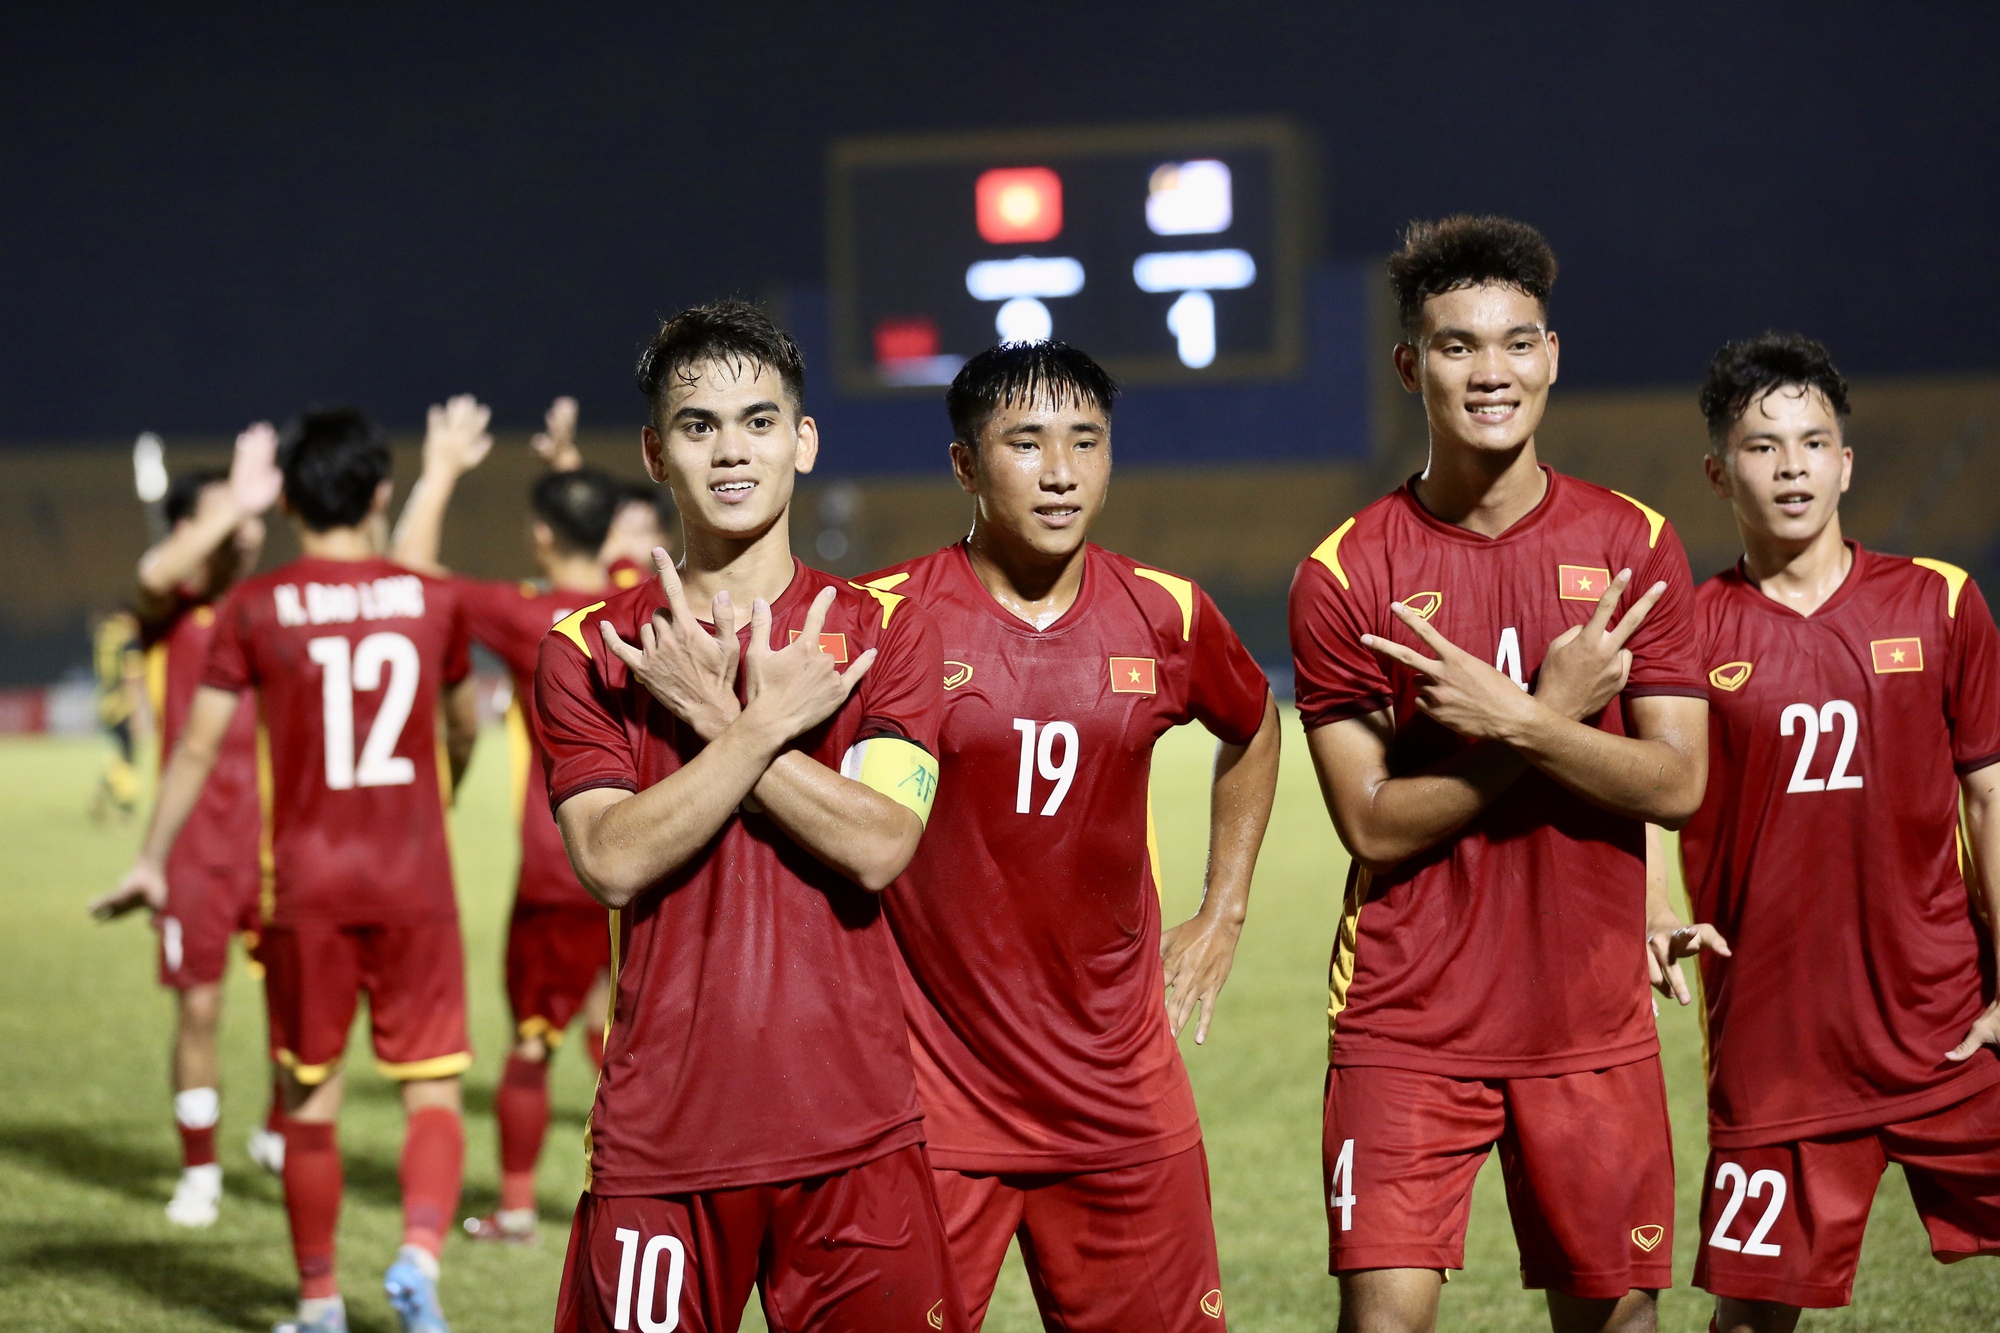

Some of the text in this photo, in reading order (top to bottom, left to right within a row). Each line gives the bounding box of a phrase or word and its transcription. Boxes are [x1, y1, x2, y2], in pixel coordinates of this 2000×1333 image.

[309, 632, 420, 790] 12
[1780, 700, 1863, 793] 22
[1013, 718, 1079, 816] 19
[1330, 1138, 1357, 1231] 4
[1708, 1162, 1788, 1257] 22
[613, 1226, 686, 1333] 10
